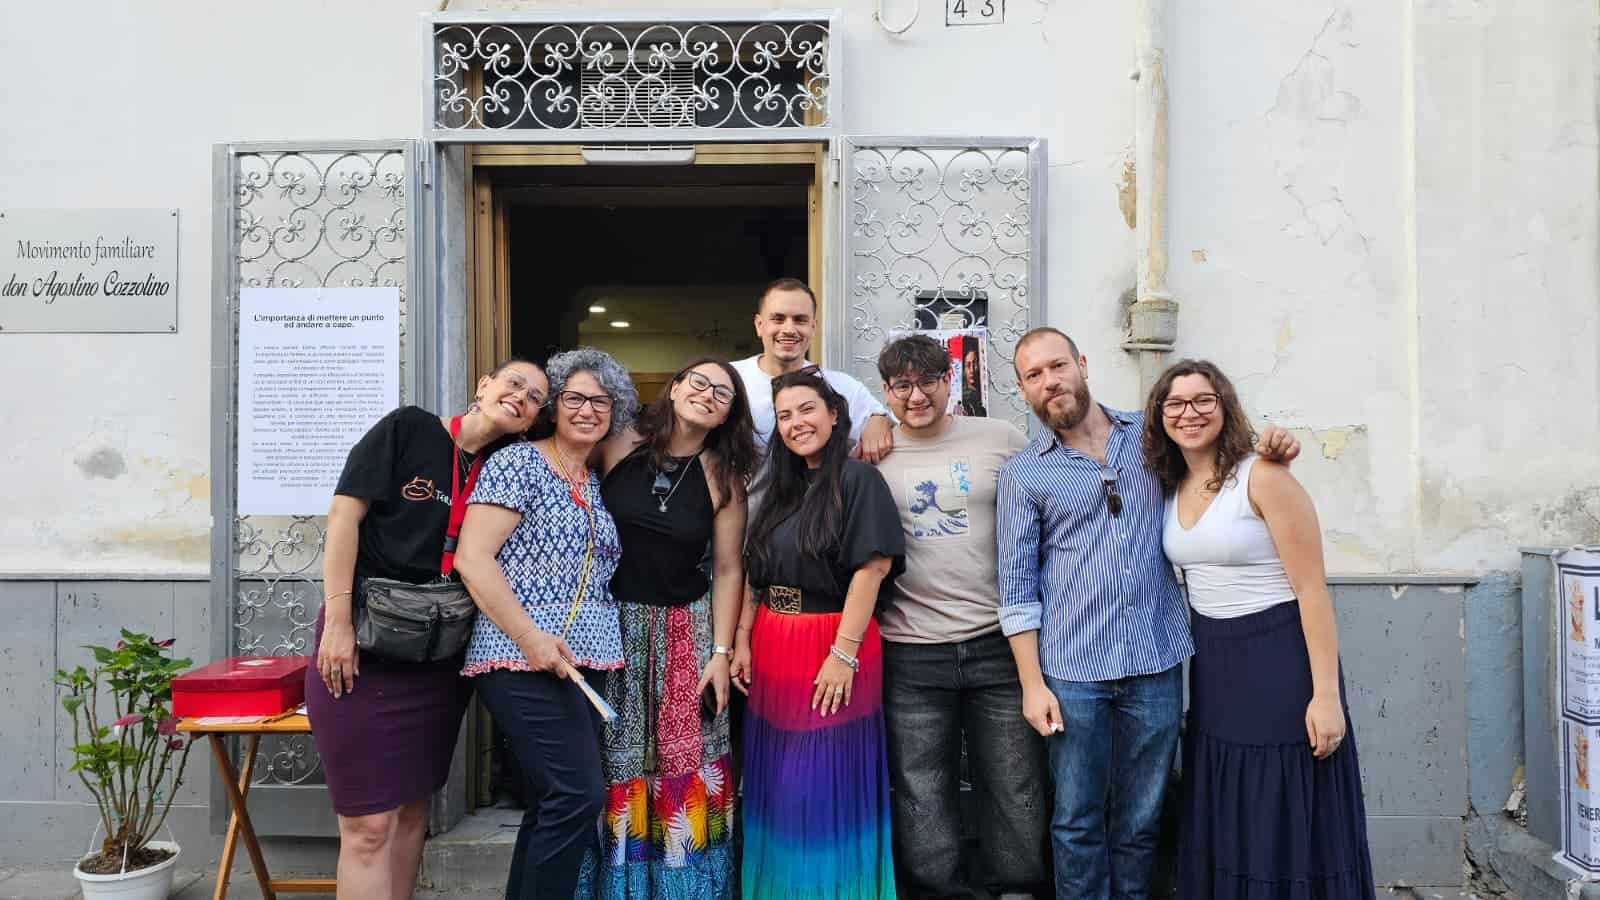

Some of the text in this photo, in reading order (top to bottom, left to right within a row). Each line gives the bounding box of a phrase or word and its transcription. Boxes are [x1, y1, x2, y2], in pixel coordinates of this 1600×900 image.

[17, 235, 156, 266] Movimento familiare
[1, 270, 170, 305] don Agostino Cozzolino
[254, 314, 306, 322] L'importanza
[308, 314, 316, 322] di
[317, 314, 350, 322] mettere
[361, 313, 385, 322] punto
